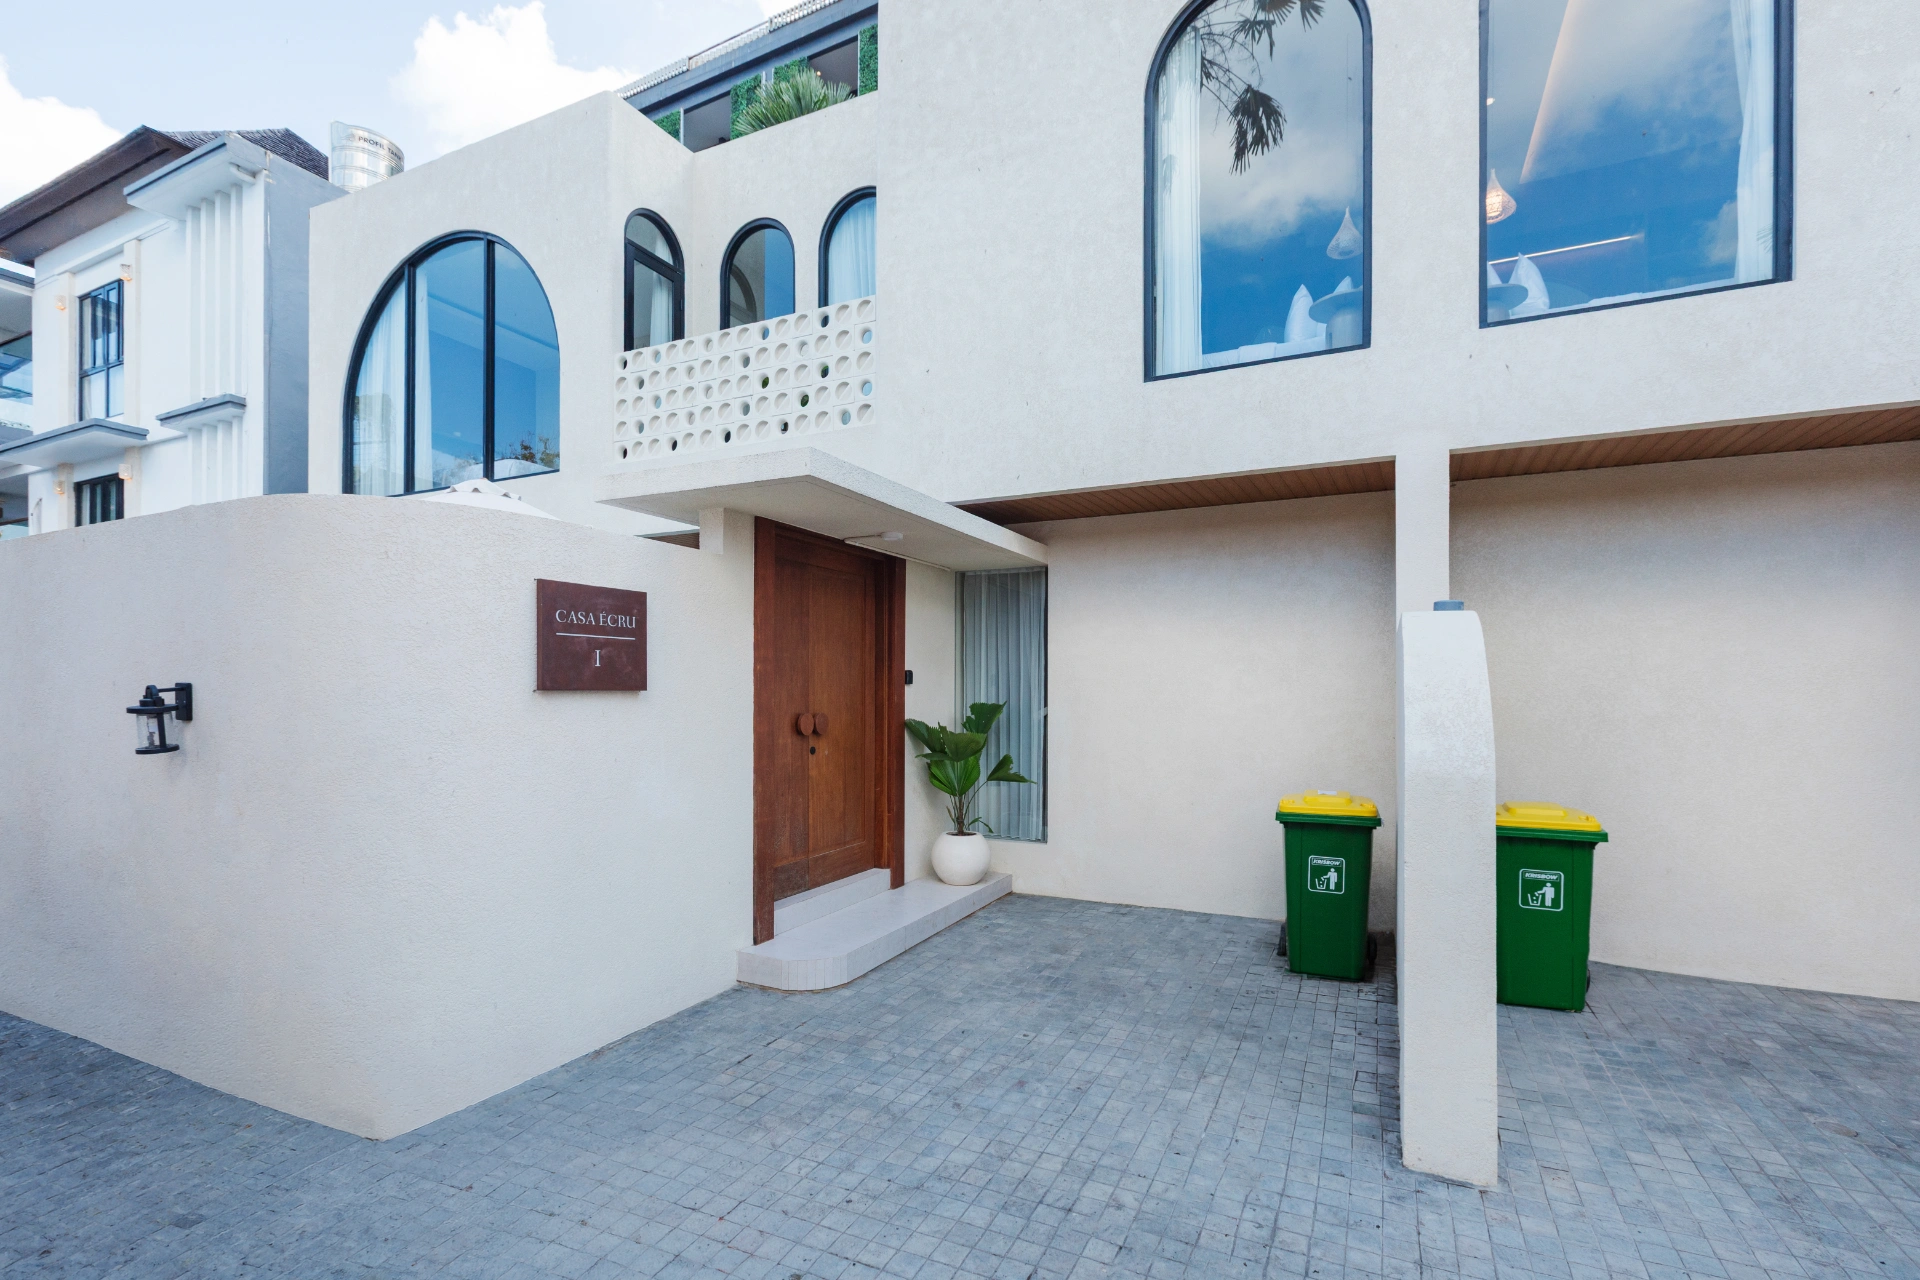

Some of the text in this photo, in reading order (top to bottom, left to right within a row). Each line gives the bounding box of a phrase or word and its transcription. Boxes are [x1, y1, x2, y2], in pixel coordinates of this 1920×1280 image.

[358, 136, 385, 150] PROFIL
[555, 609, 636, 628] CASA ÉCRU
[1525, 872, 1558, 880] KRISBOW
